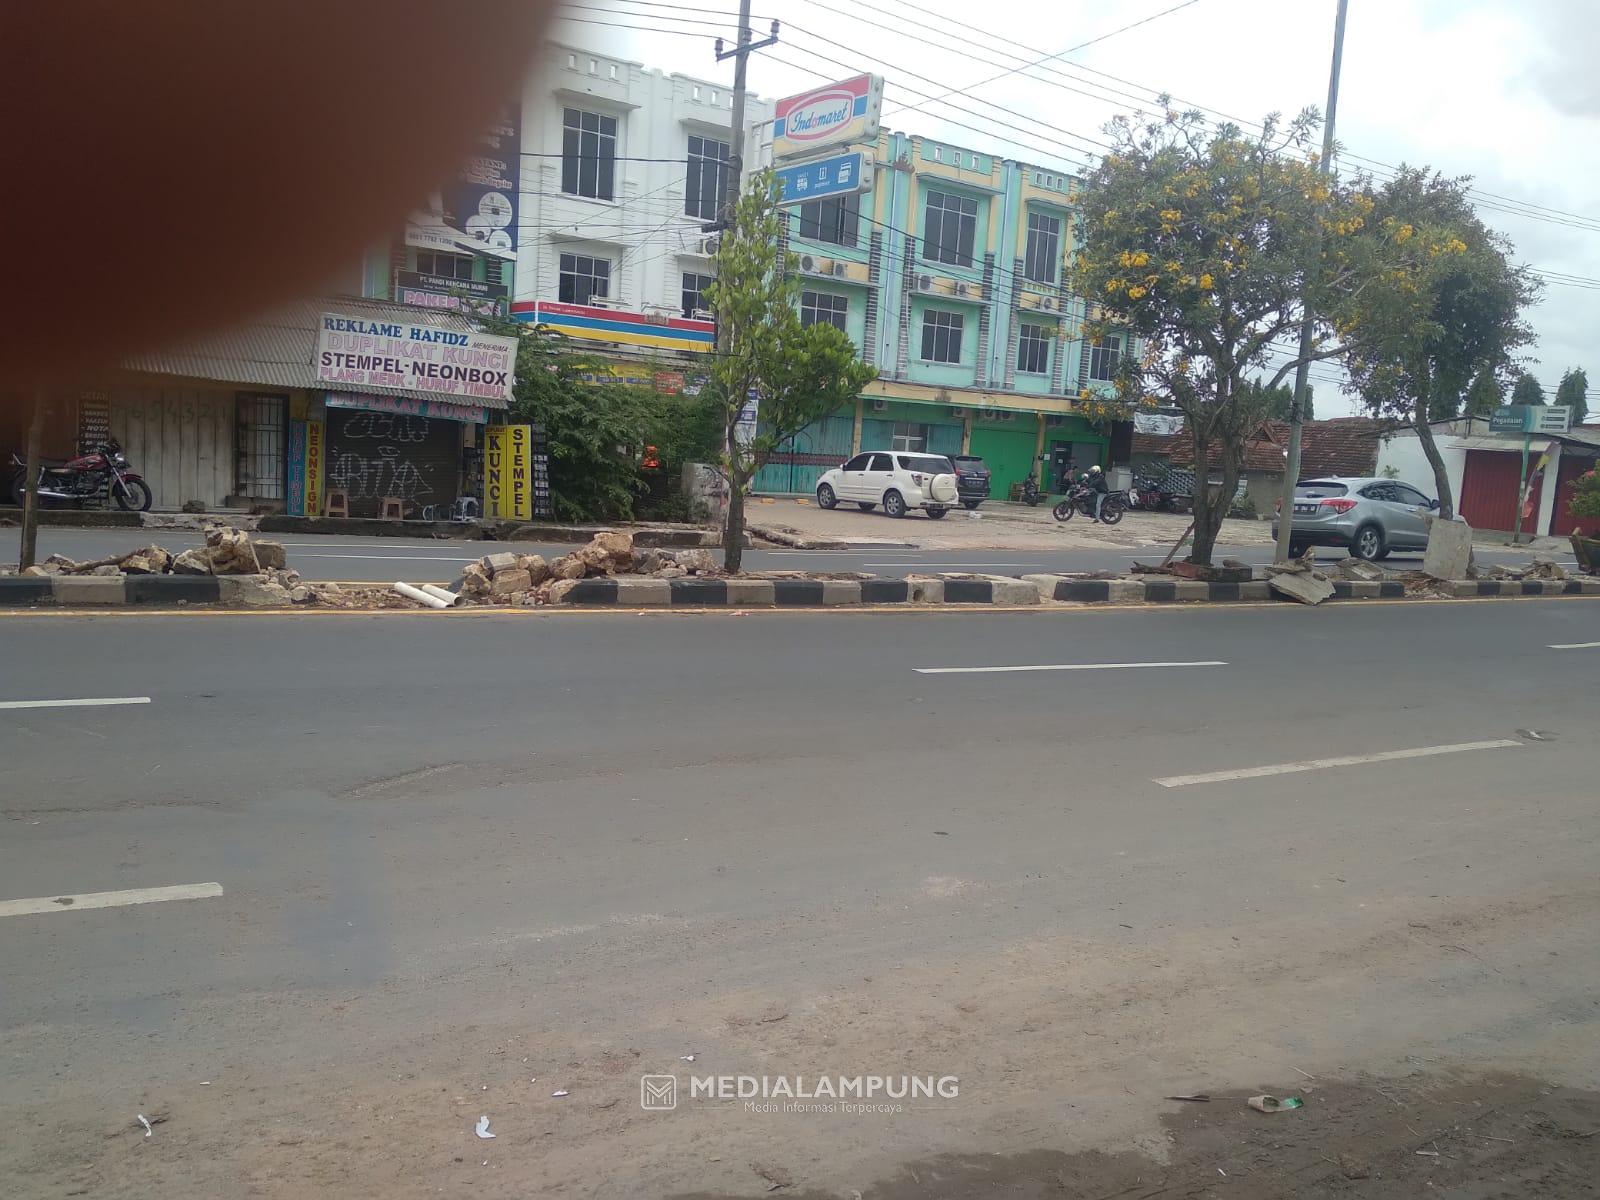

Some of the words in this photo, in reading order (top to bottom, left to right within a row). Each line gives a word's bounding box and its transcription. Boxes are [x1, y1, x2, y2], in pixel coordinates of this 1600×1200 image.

[790, 102, 848, 133] Indomaret
[324, 317, 402, 338] REKLAME
[410, 328, 469, 346] HAFIDZ
[328, 333, 434, 360] DUPLIKAT
[442, 346, 508, 370] KUNCI
[320, 367, 364, 382] PLANG
[368, 372, 405, 386] MERK
[416, 378, 458, 393] HURUF
[463, 381, 505, 399] TIMBUL
[332, 392, 422, 415] DUPLIKAT
[427, 402, 484, 420] KUNCI
[307, 424, 319, 513] NEONSIGN
[488, 436, 501, 517] KUNCI
[512, 428, 524, 517] STEMPEL
